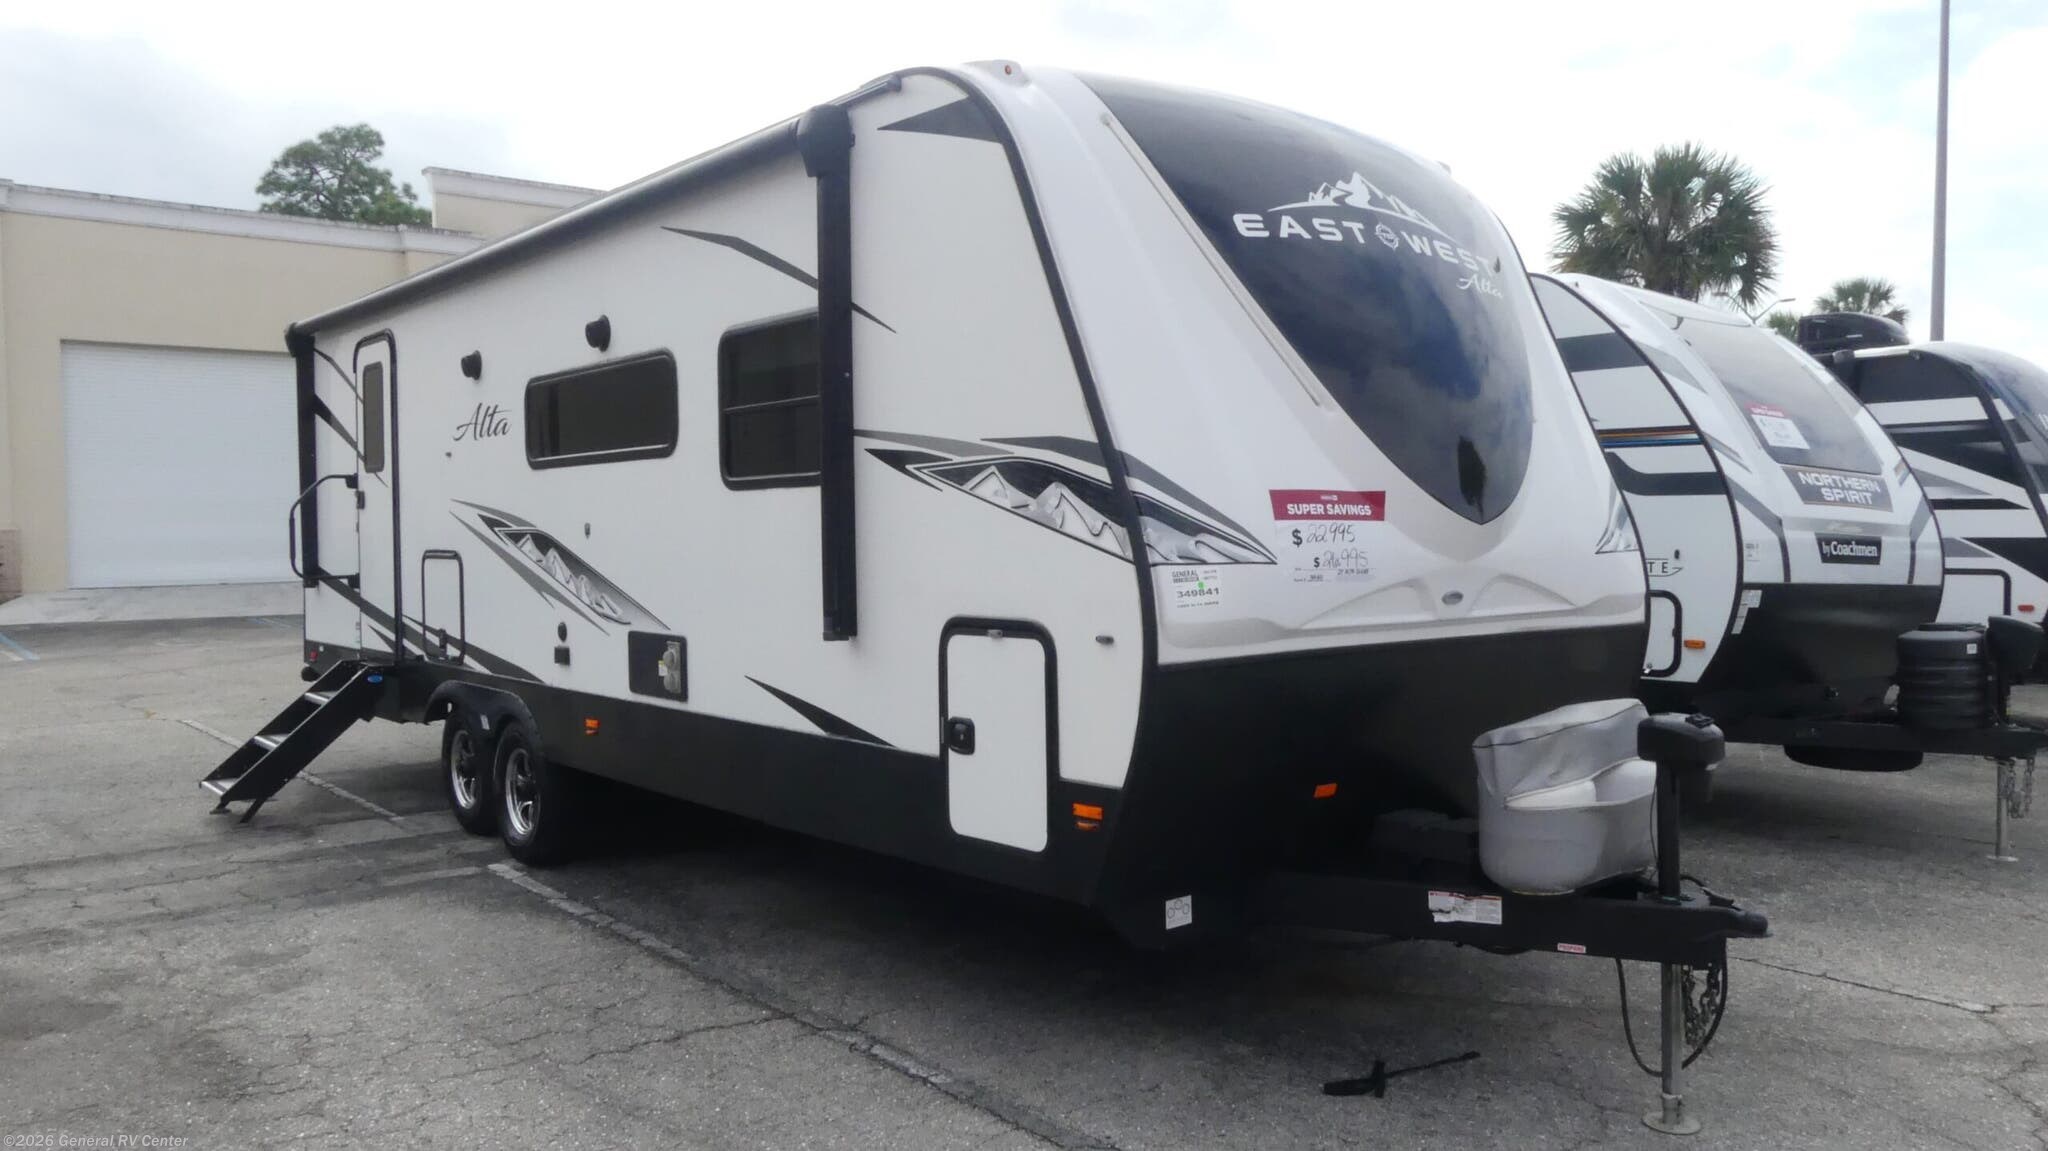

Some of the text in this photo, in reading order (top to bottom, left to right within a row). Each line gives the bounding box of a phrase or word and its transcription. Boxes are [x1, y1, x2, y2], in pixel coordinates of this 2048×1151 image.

[1232, 213, 1495, 278] EAST WEST
[1456, 273, 1504, 299] Alta
[452, 402, 513, 442] Alta
[1797, 471, 1882, 493] NORTHERN
[1820, 486, 1873, 505] SPIRIT
[1287, 503, 1372, 517] SUPER SAVINGS
[1291, 528, 1304, 549] $
[1820, 540, 1878, 558] by Coachmen
[1313, 557, 1321, 570] $
